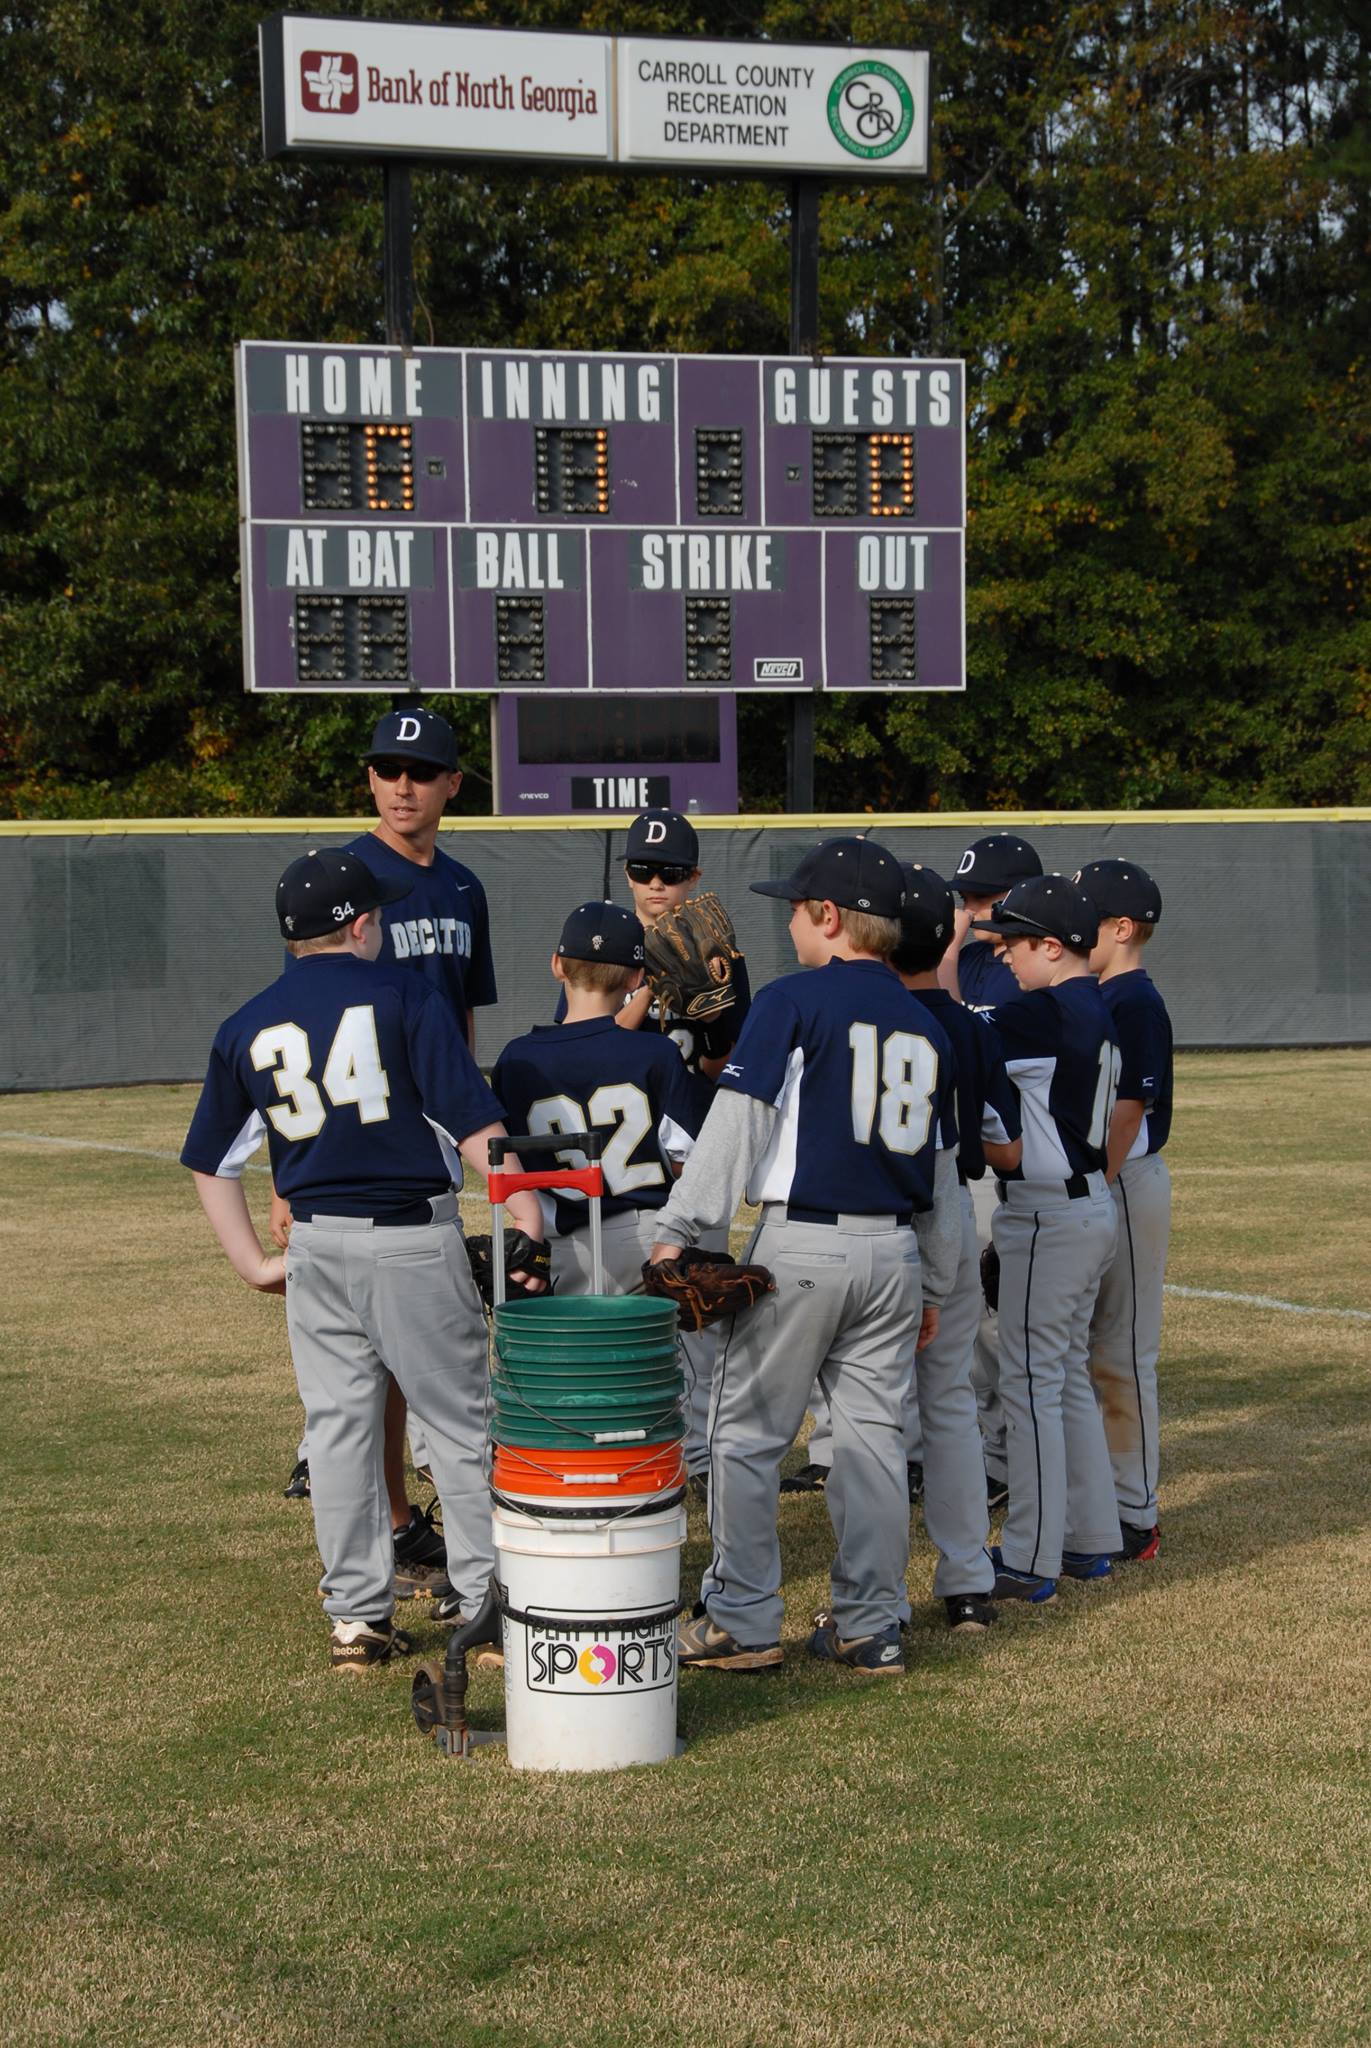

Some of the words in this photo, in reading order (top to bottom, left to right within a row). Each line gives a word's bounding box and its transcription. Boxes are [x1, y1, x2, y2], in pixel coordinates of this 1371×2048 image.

[367, 67, 422, 104] Bank
[429, 72, 451, 106] of
[456, 72, 514, 109] North
[521, 77, 597, 120] Georgia
[639, 60, 726, 84] CARROLL
[736, 65, 813, 88] COUNTY
[668, 92, 786, 116] RECREATION
[665, 122, 788, 146] DEPARTMENT
[286, 355, 422, 416] HOME
[482, 361, 659, 421] INNING
[775, 368, 950, 425] GUESTS
[871, 436, 912, 514] 0
[287, 529, 327, 586] AT
[348, 531, 413, 587] BAT
[477, 533, 563, 588] BALL
[643, 535, 771, 589] STRIKE
[859, 536, 928, 590] OUT
[397, 718, 420, 740] D
[594, 778, 648, 807] TIME
[646, 822, 666, 842] D
[957, 851, 975, 873] D
[332, 901, 355, 922] 34
[250, 1004, 390, 1142] 34
[849, 1021, 938, 1156] 18
[527, 1082, 666, 1201] 32
[531, 1636, 673, 1686] SPORTS
